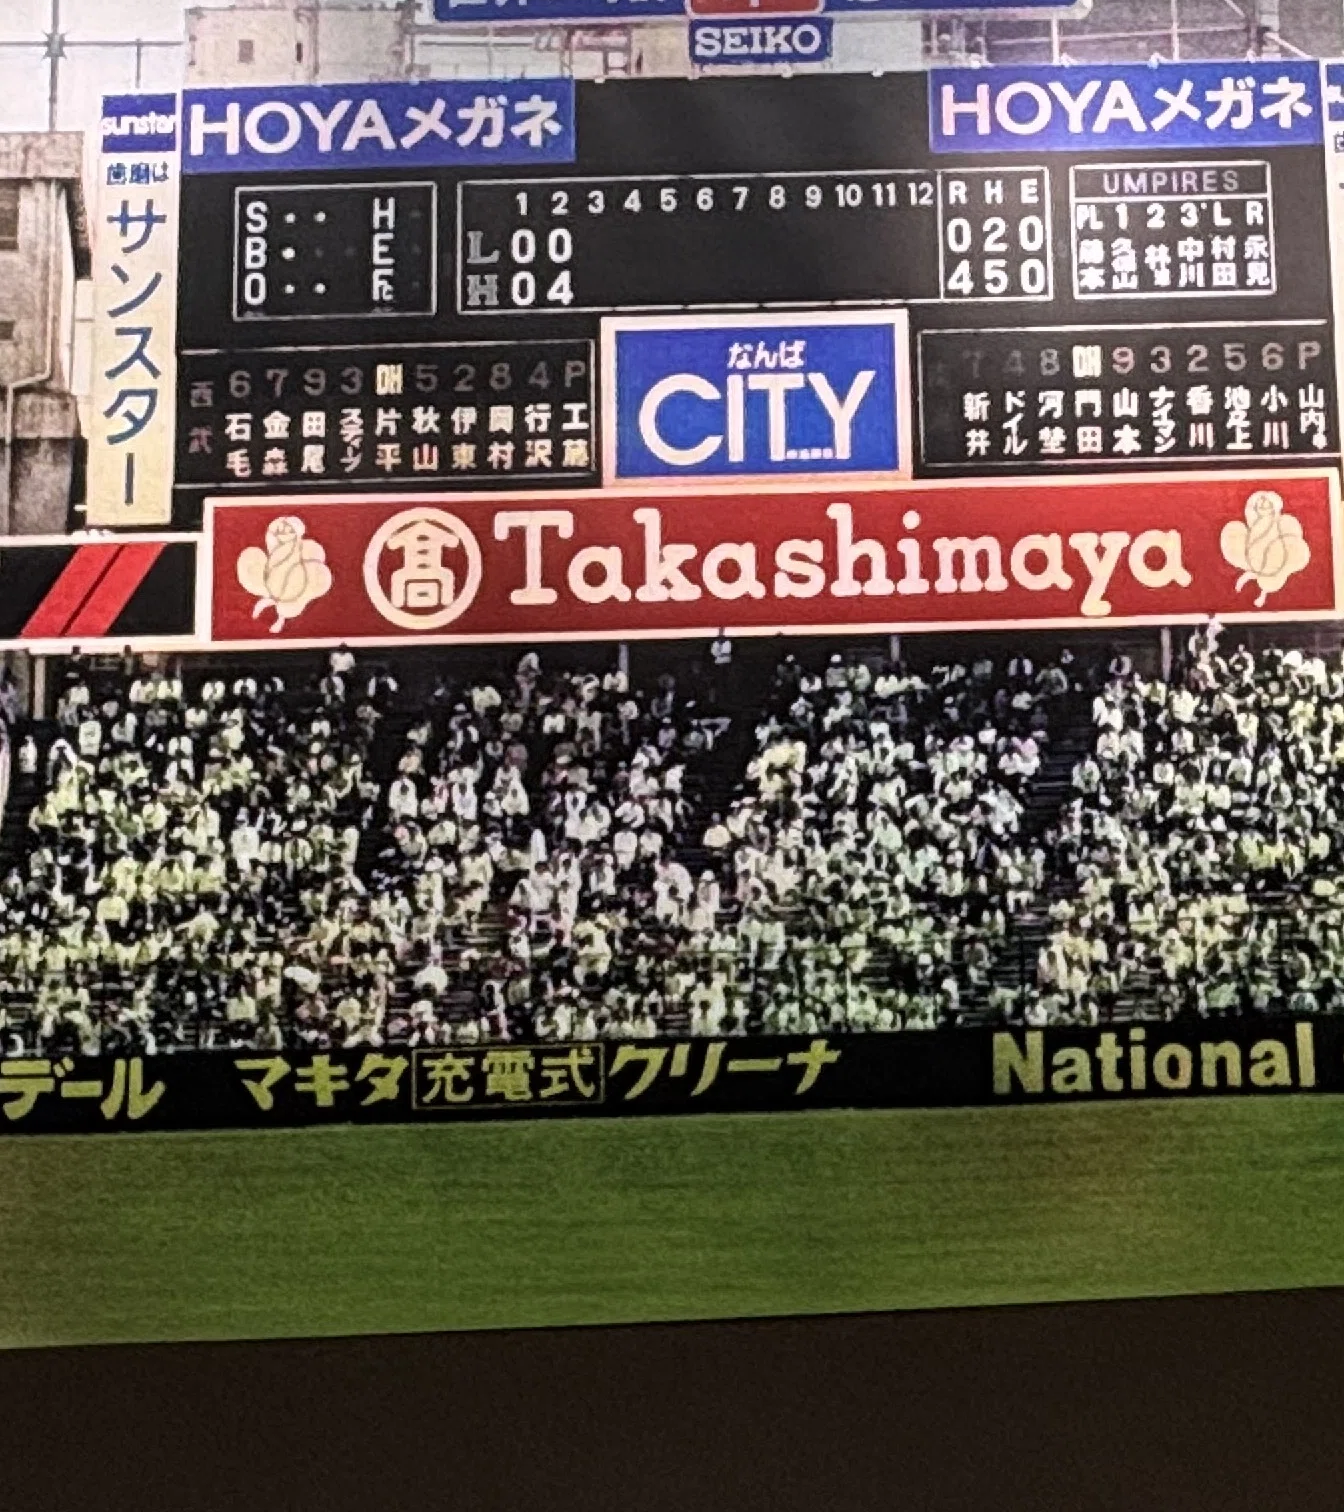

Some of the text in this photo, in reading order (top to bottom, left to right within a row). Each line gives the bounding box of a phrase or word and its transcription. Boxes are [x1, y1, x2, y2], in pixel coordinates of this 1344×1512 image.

[694, 21, 821, 57] SEIKO
[190, 94, 562, 156] HOYAメガネ
[942, 77, 1313, 137] HOYAメガネ
[516, 178, 1039, 216] 1 2 3 4 5 6 7 8 9 10 11 12 R H E
[1103, 170, 1240, 194] UMPIRES
[246, 196, 396, 234] S H
[467, 215, 1044, 264] L 0 0 0 2 0
[1076, 200, 1264, 230] PL 1 2 3 L R
[245, 232, 395, 270] B E
[1177, 236, 1206, 288] 中川
[466, 258, 1045, 306] H 0 4 4 5 0
[103, 198, 168, 506] サンスター
[229, 370, 252, 398] 6
[266, 368, 289, 397] 7
[304, 368, 326, 396] 9
[340, 366, 364, 395] 3
[416, 363, 439, 392] 5
[453, 362, 476, 392] 2
[489, 362, 512, 390] 8
[528, 360, 550, 389] 4
[564, 360, 586, 388] P
[726, 340, 807, 370] なんば
[1040, 348, 1060, 376] 8
[1112, 346, 1135, 374] 9
[1150, 345, 1172, 374] 3
[1186, 344, 1209, 372] 2
[1223, 342, 1247, 371] 5
[1261, 342, 1284, 370] 6
[1298, 340, 1321, 370] P
[225, 412, 254, 478] 石毛
[374, 406, 403, 472] 片平
[411, 404, 441, 471] 秋山
[638, 370, 877, 466] CITY
[1074, 389, 1103, 454] 門田
[1112, 387, 1142, 455] 山本
[1260, 384, 1290, 450] 小川
[493, 503, 1192, 617] Takashimaya
[992, 1020, 1316, 1095] National
